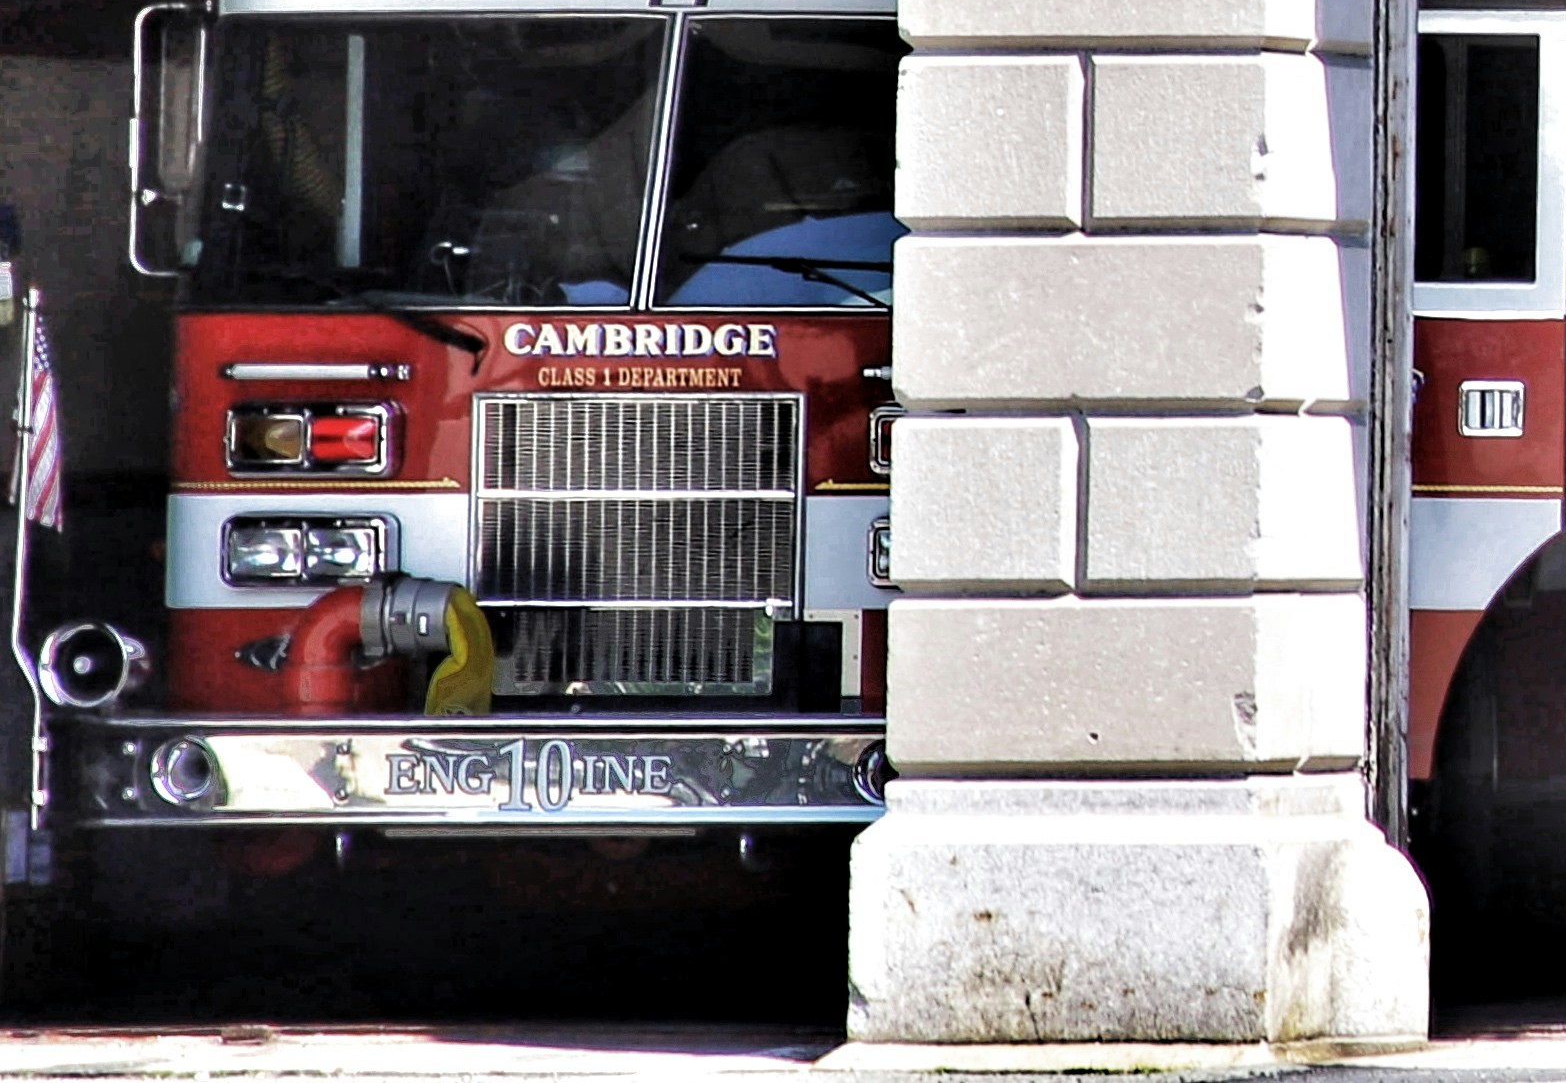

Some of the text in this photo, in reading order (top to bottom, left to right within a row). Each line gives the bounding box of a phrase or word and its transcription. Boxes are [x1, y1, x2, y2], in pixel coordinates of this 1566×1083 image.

[504, 323, 776, 358] CAMBRIDGE
[538, 368, 742, 387] CLASS 1 DEPARTMENT
